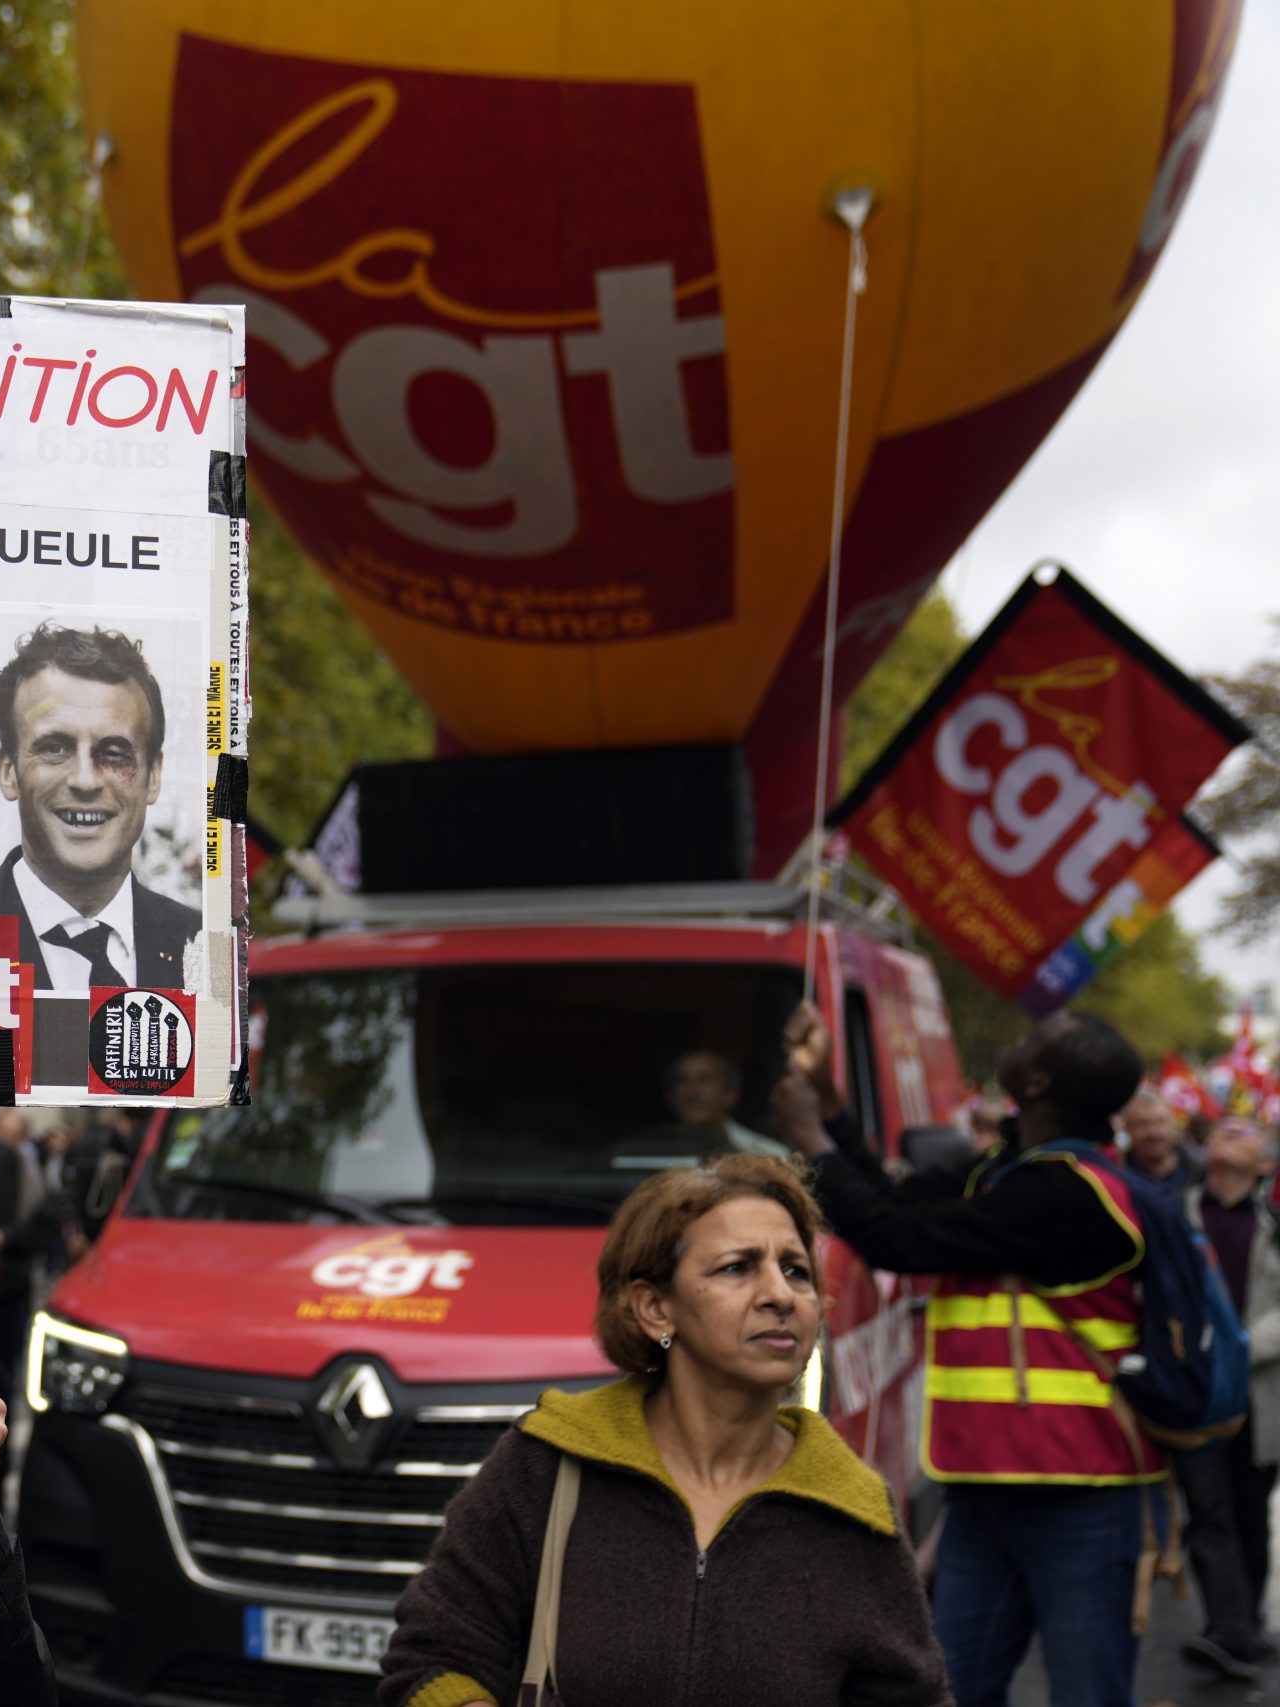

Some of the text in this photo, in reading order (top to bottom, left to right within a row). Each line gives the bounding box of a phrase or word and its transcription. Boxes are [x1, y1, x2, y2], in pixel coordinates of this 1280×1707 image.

[230, 561, 240, 598] TOUS
[934, 692, 1158, 906] cgt
[105, 1005, 123, 1079] RAFFINERIE
[123, 1067, 177, 1080] EN LUTTE
[312, 1250, 475, 1296] cgt
